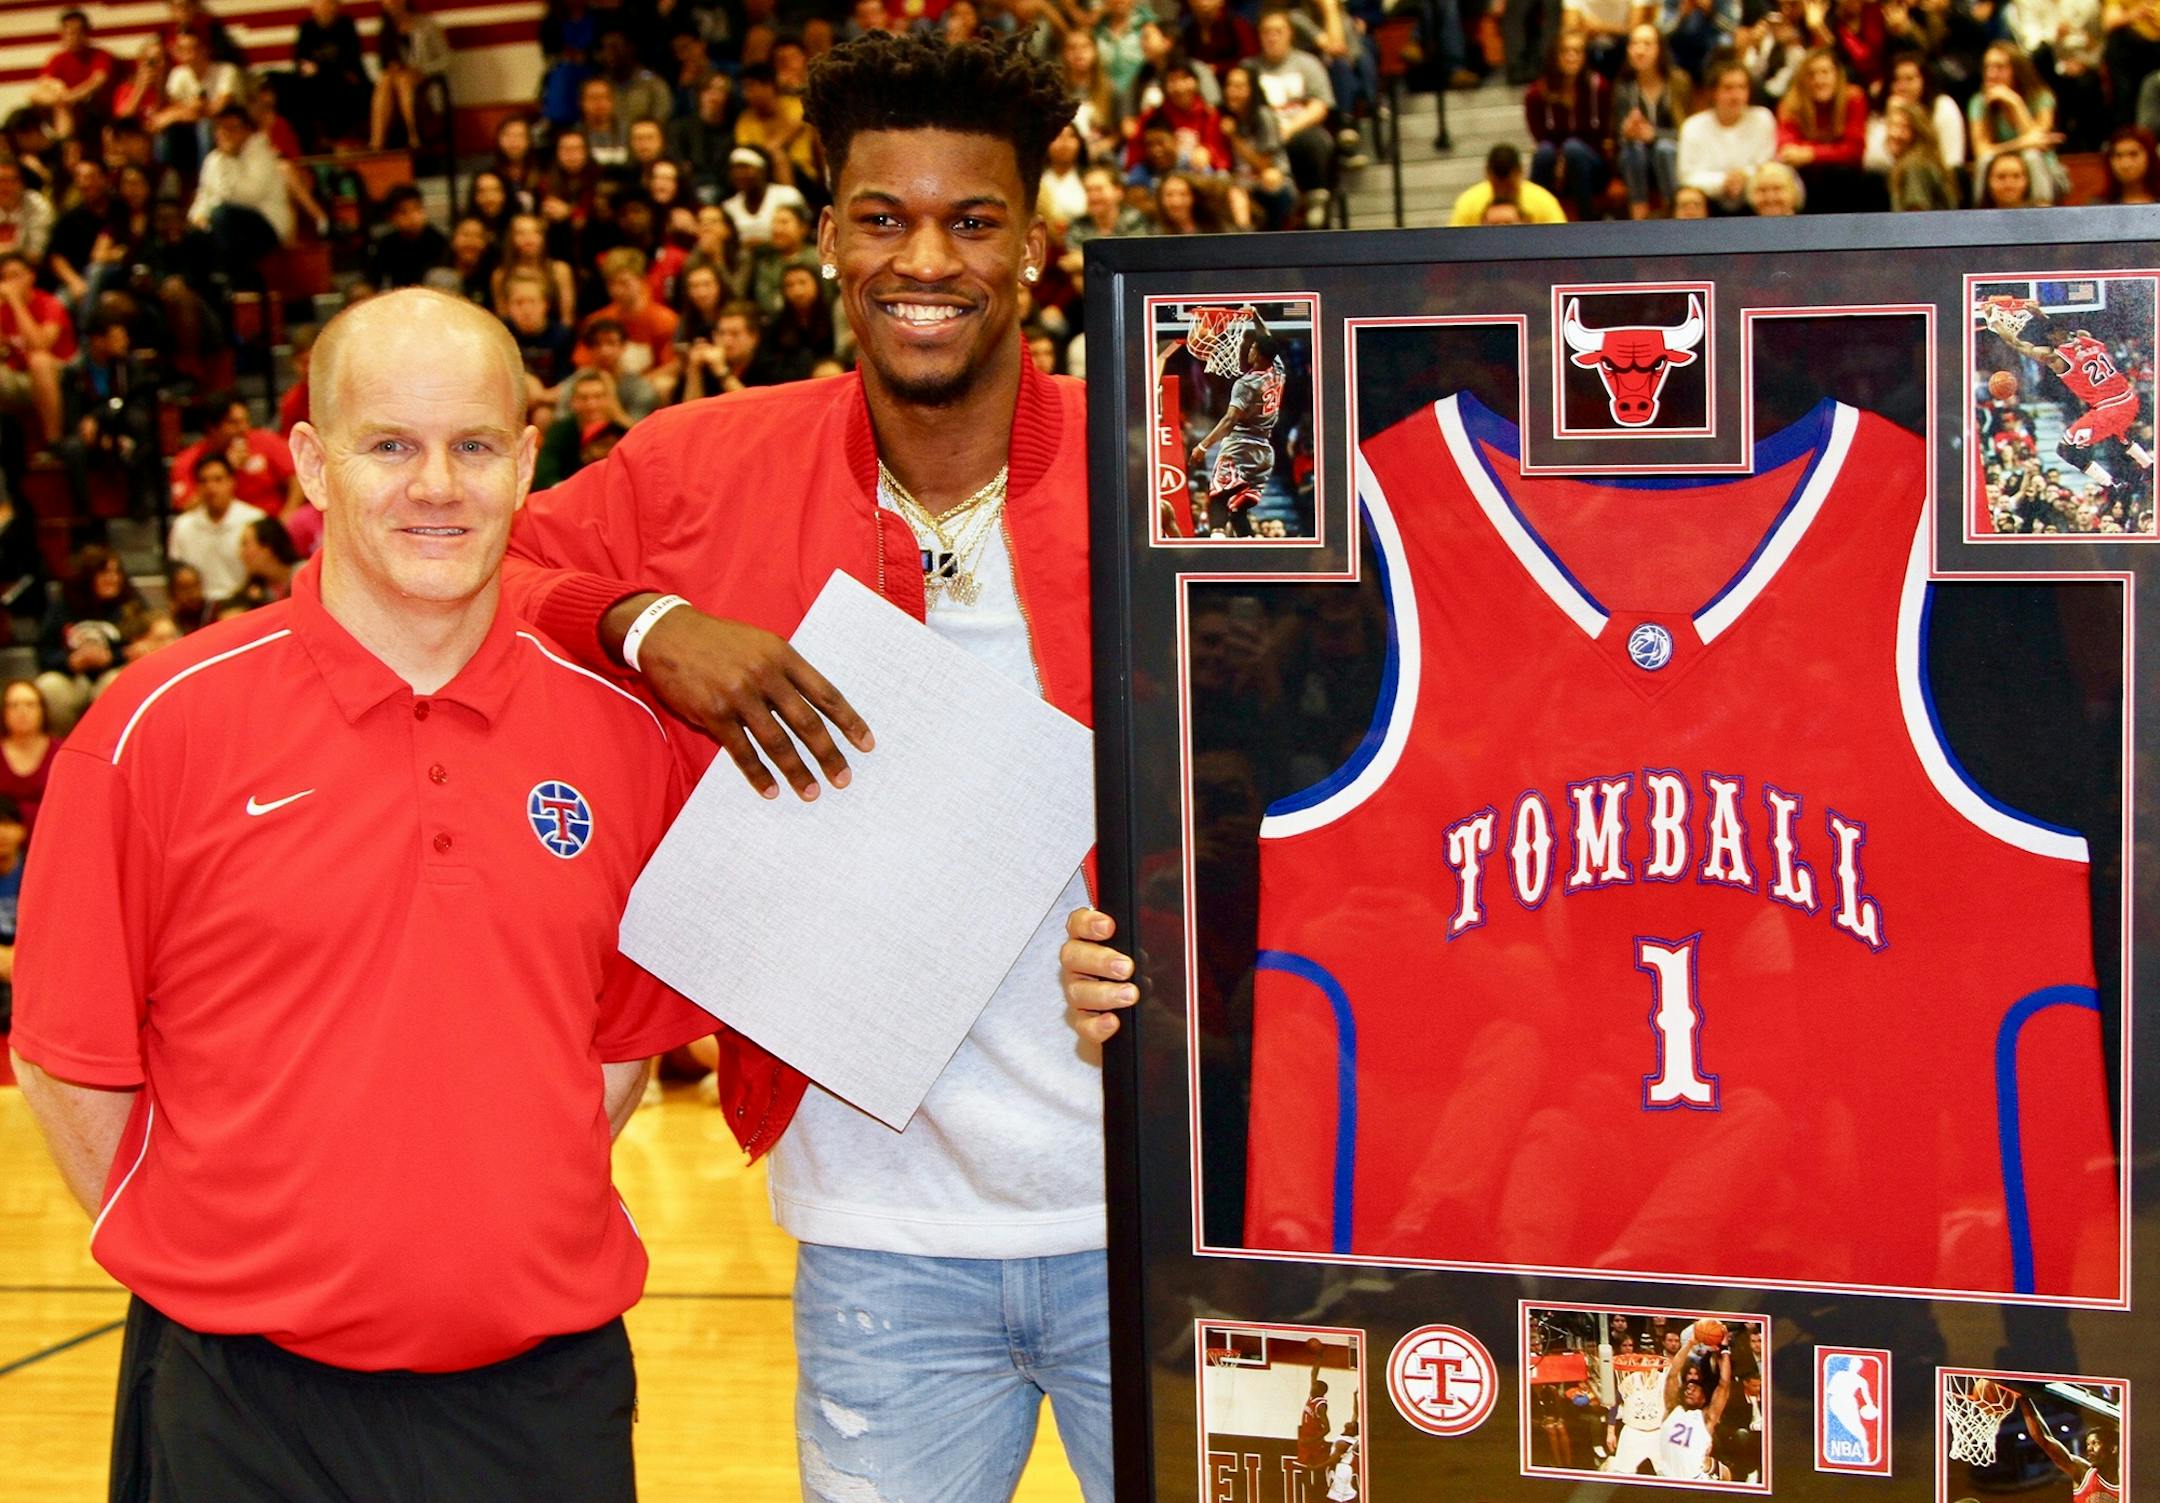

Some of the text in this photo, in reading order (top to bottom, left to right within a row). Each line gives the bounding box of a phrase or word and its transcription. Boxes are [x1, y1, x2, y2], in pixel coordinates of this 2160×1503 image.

[2082, 352, 2117, 387] 21
[1443, 768, 1888, 952] TOMBALL
[1634, 933, 1720, 1111] 1
[1418, 1356, 1463, 1407] T
[1669, 1422, 1693, 1448] 21
[1830, 1439, 1863, 1458] NBA
